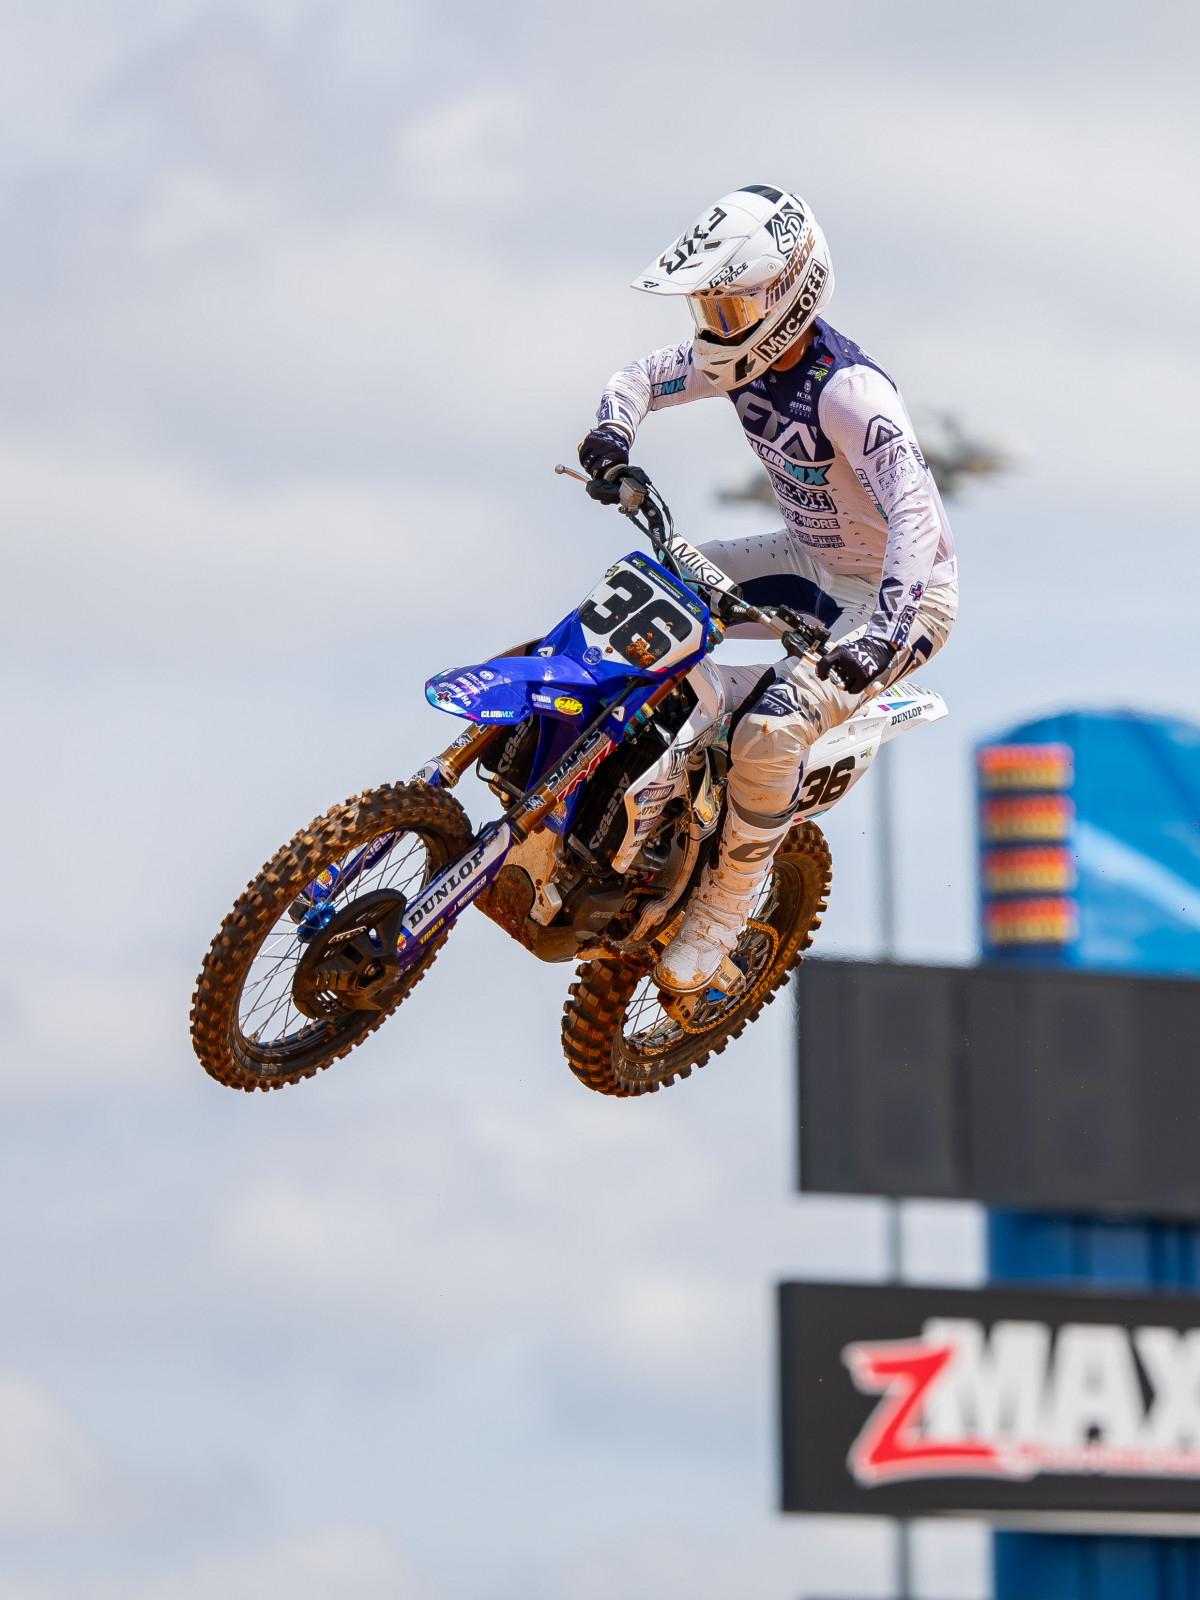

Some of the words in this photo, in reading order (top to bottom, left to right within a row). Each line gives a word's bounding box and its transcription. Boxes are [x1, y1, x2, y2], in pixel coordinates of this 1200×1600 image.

[760, 265, 825, 359] Muc-Off
[651, 377, 685, 397] BMX
[579, 569, 693, 669] 36
[891, 706, 922, 726] DUNLOP
[800, 757, 855, 811] 36
[409, 850, 484, 929] DUNLOP
